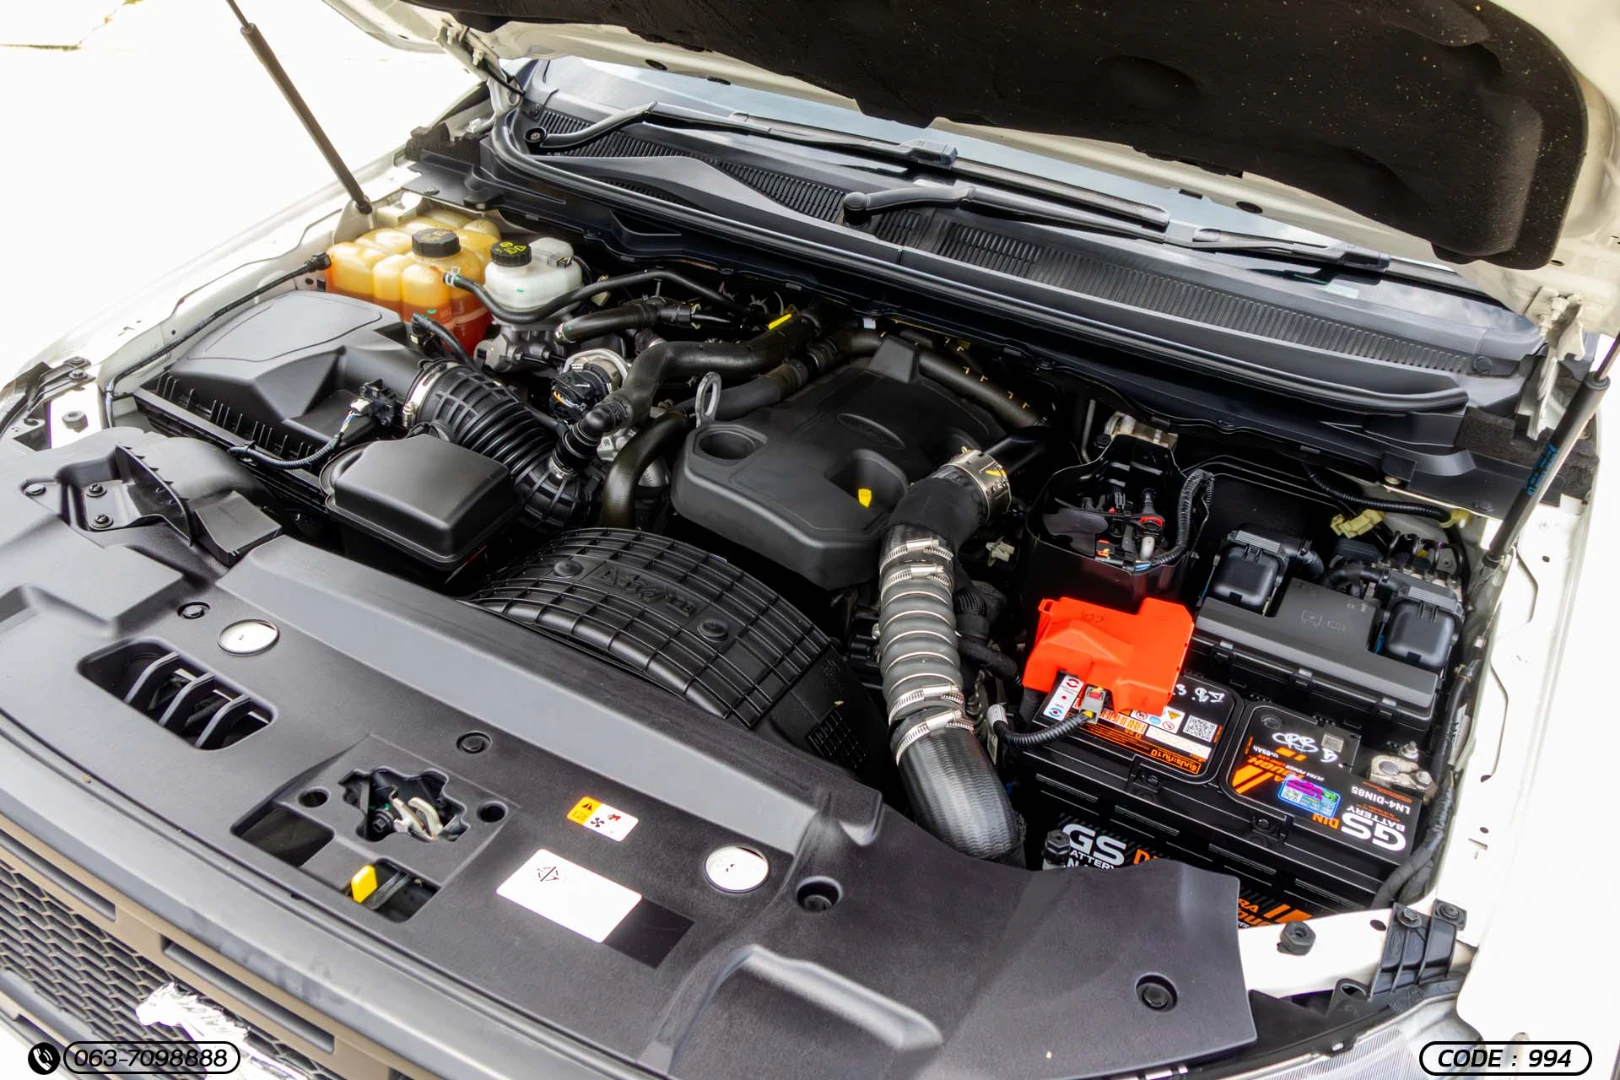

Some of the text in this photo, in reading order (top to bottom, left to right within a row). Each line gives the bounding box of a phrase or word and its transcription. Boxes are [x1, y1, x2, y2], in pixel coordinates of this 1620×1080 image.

[1351, 785, 1411, 815] LN4-DIN85
[1312, 813, 1340, 830] DIN
[1341, 812, 1407, 852] GS
[1346, 805, 1406, 832] BATTERY
[1062, 823, 1127, 866] GS
[1069, 849, 1115, 870] ATTER
